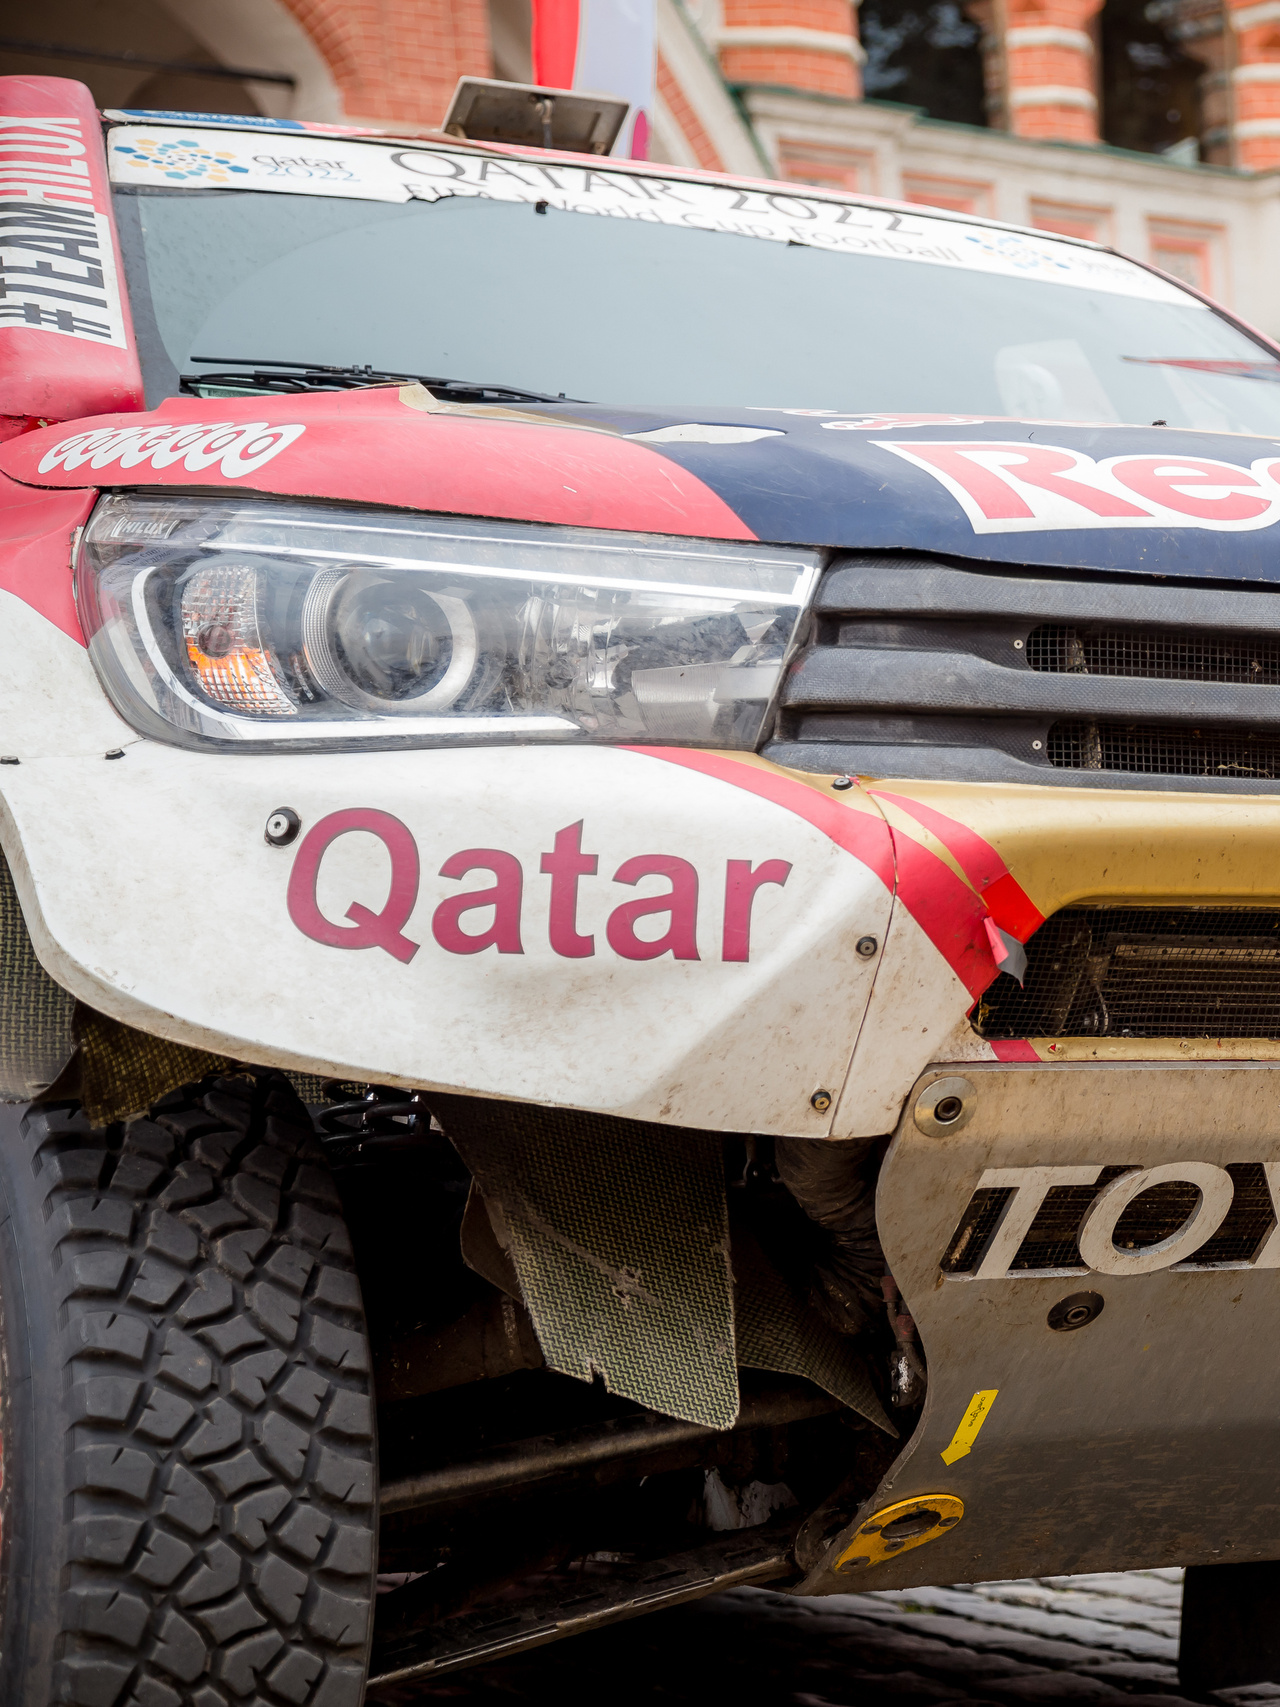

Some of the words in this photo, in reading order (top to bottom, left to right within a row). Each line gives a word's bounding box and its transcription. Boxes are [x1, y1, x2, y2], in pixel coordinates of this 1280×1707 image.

[252, 155, 346, 170] qatar
[264, 165, 361, 182] 2022
[391, 151, 696, 204] QATAR
[711, 184, 923, 236] 2022
[682, 213, 774, 239] Cup
[790, 225, 964, 262] Football
[122, 521, 169, 535] HILUX
[286, 807, 793, 965] Qatar
